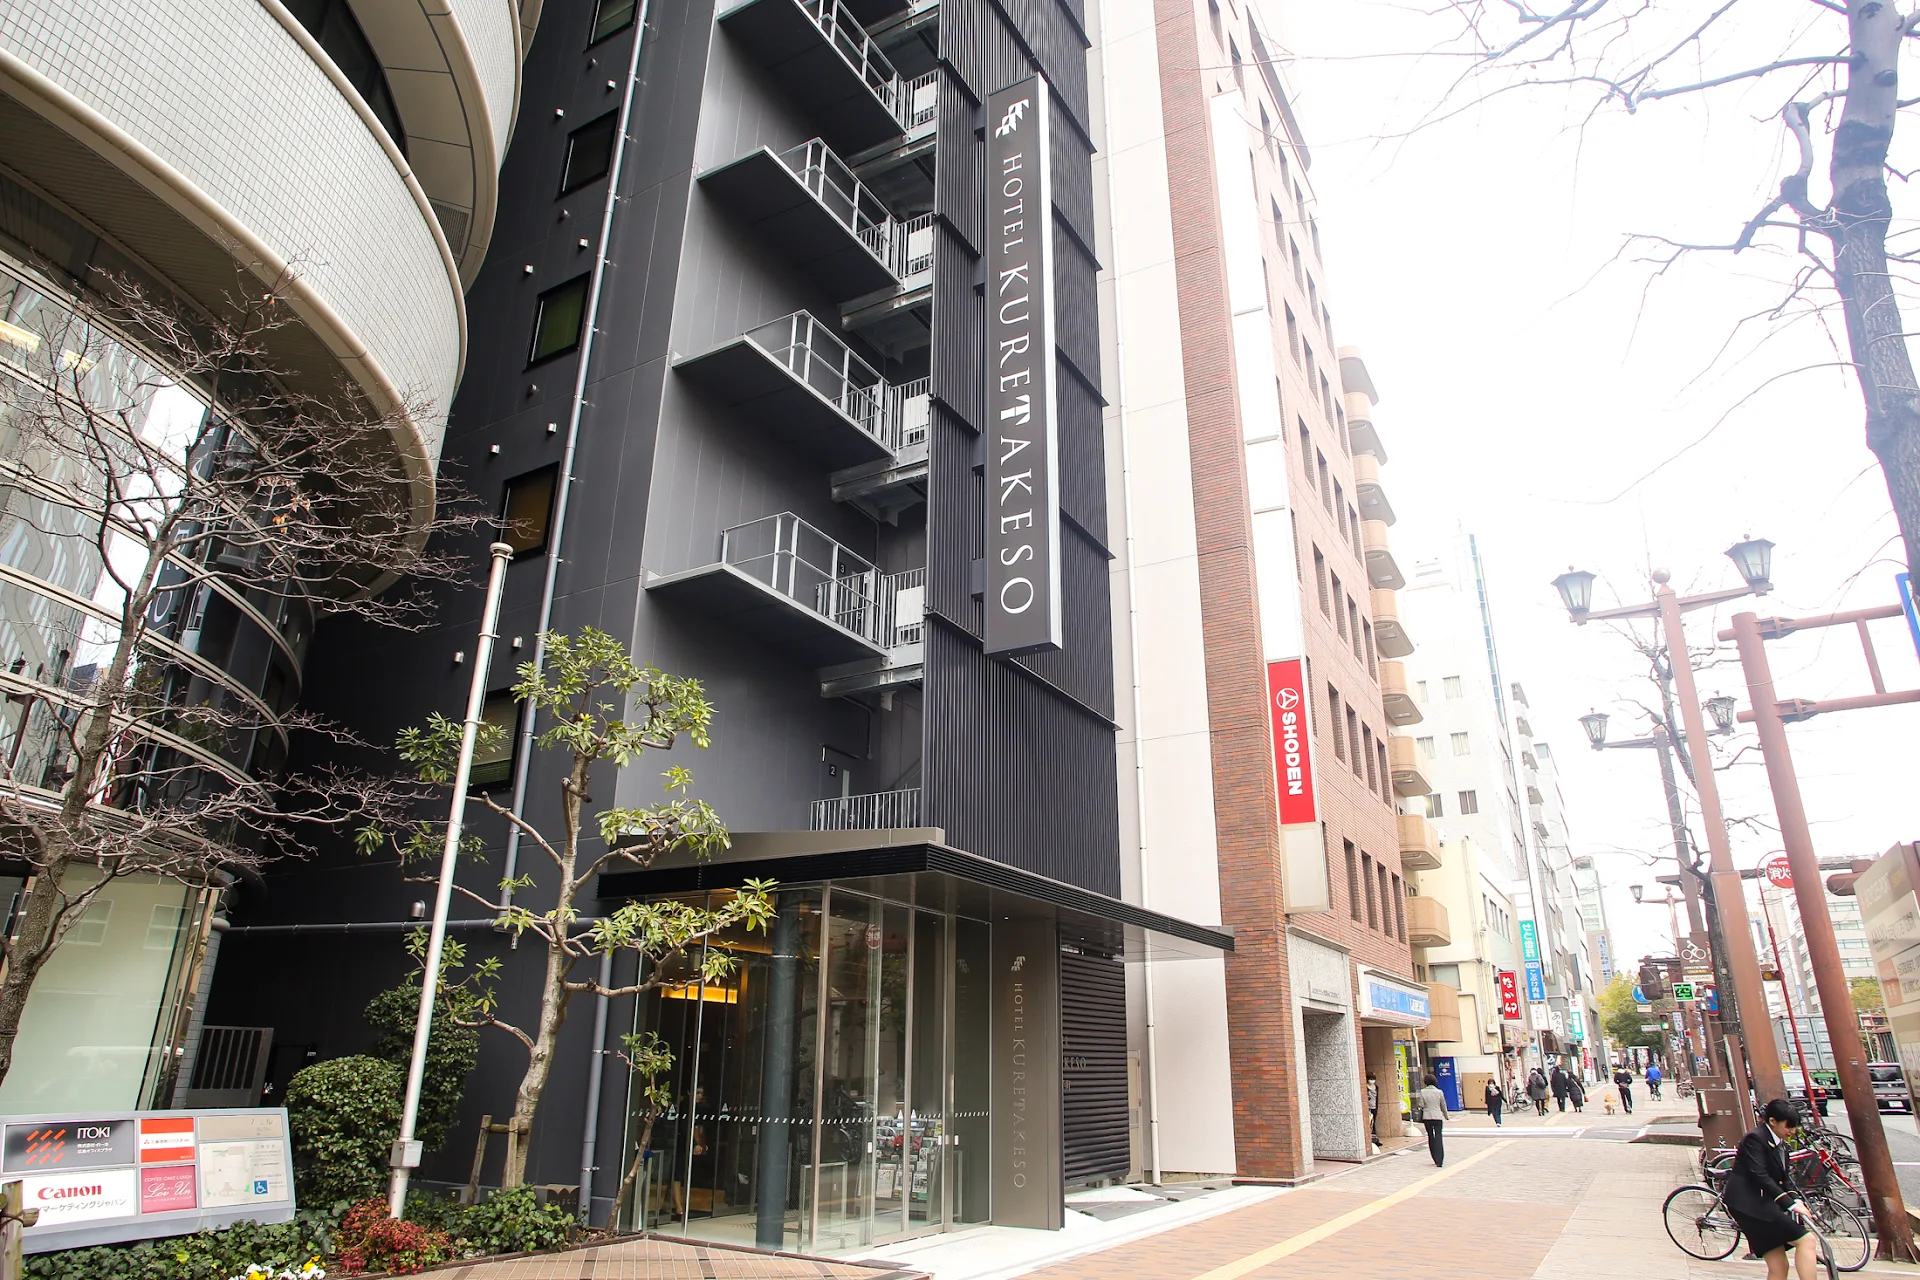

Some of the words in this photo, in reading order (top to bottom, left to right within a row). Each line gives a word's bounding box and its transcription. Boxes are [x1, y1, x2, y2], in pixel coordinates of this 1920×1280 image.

[1003, 152, 1024, 254] HOTEL
[1000, 262, 1034, 614] KURETAKESO
[1281, 711, 1303, 795] SHODEN
[830, 766, 836, 775] 2
[1767, 866, 1793, 880] 消火
[1014, 982, 1024, 1032] HOTEL
[1012, 1038, 1027, 1188] KURETAKESO
[77, 1126, 111, 1139] ITOKI
[37, 1185, 102, 1200] Canon
[39, 1198, 127, 1212] マーケティングジャパン
